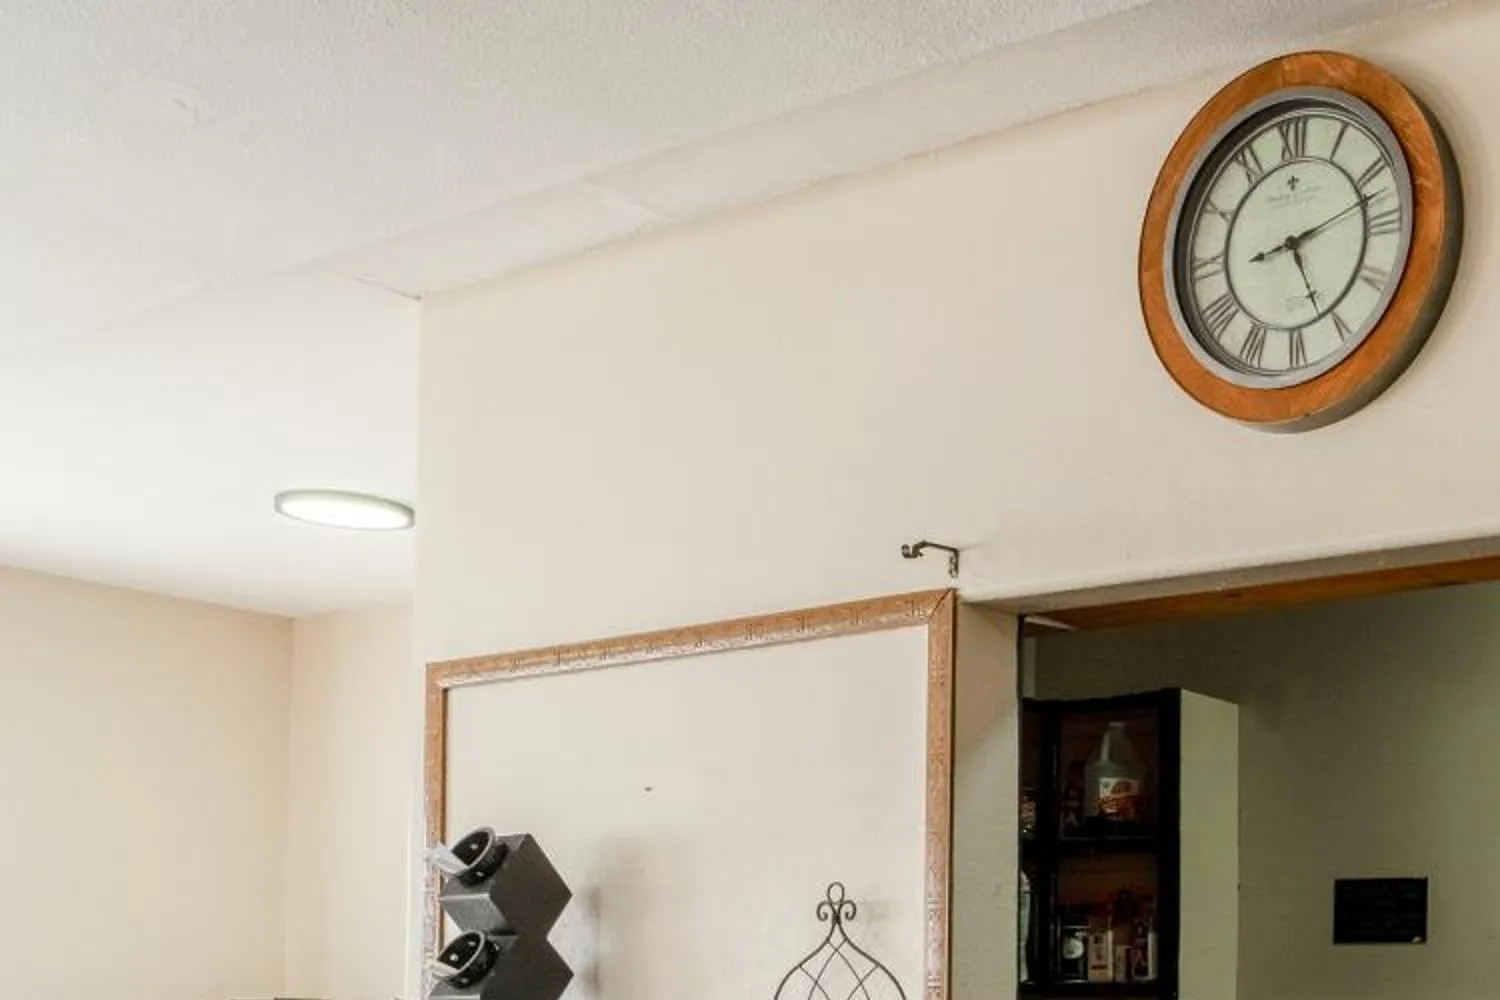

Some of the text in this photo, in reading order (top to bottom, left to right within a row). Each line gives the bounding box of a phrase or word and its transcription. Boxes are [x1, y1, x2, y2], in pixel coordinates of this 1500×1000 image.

[1276, 114, 1309, 162] XII
[1232, 144, 1264, 185] XI
[1356, 155, 1389, 190] II
[1368, 208, 1402, 237] III
[1239, 323, 1267, 369] VII
[1289, 328, 1308, 368] VI
